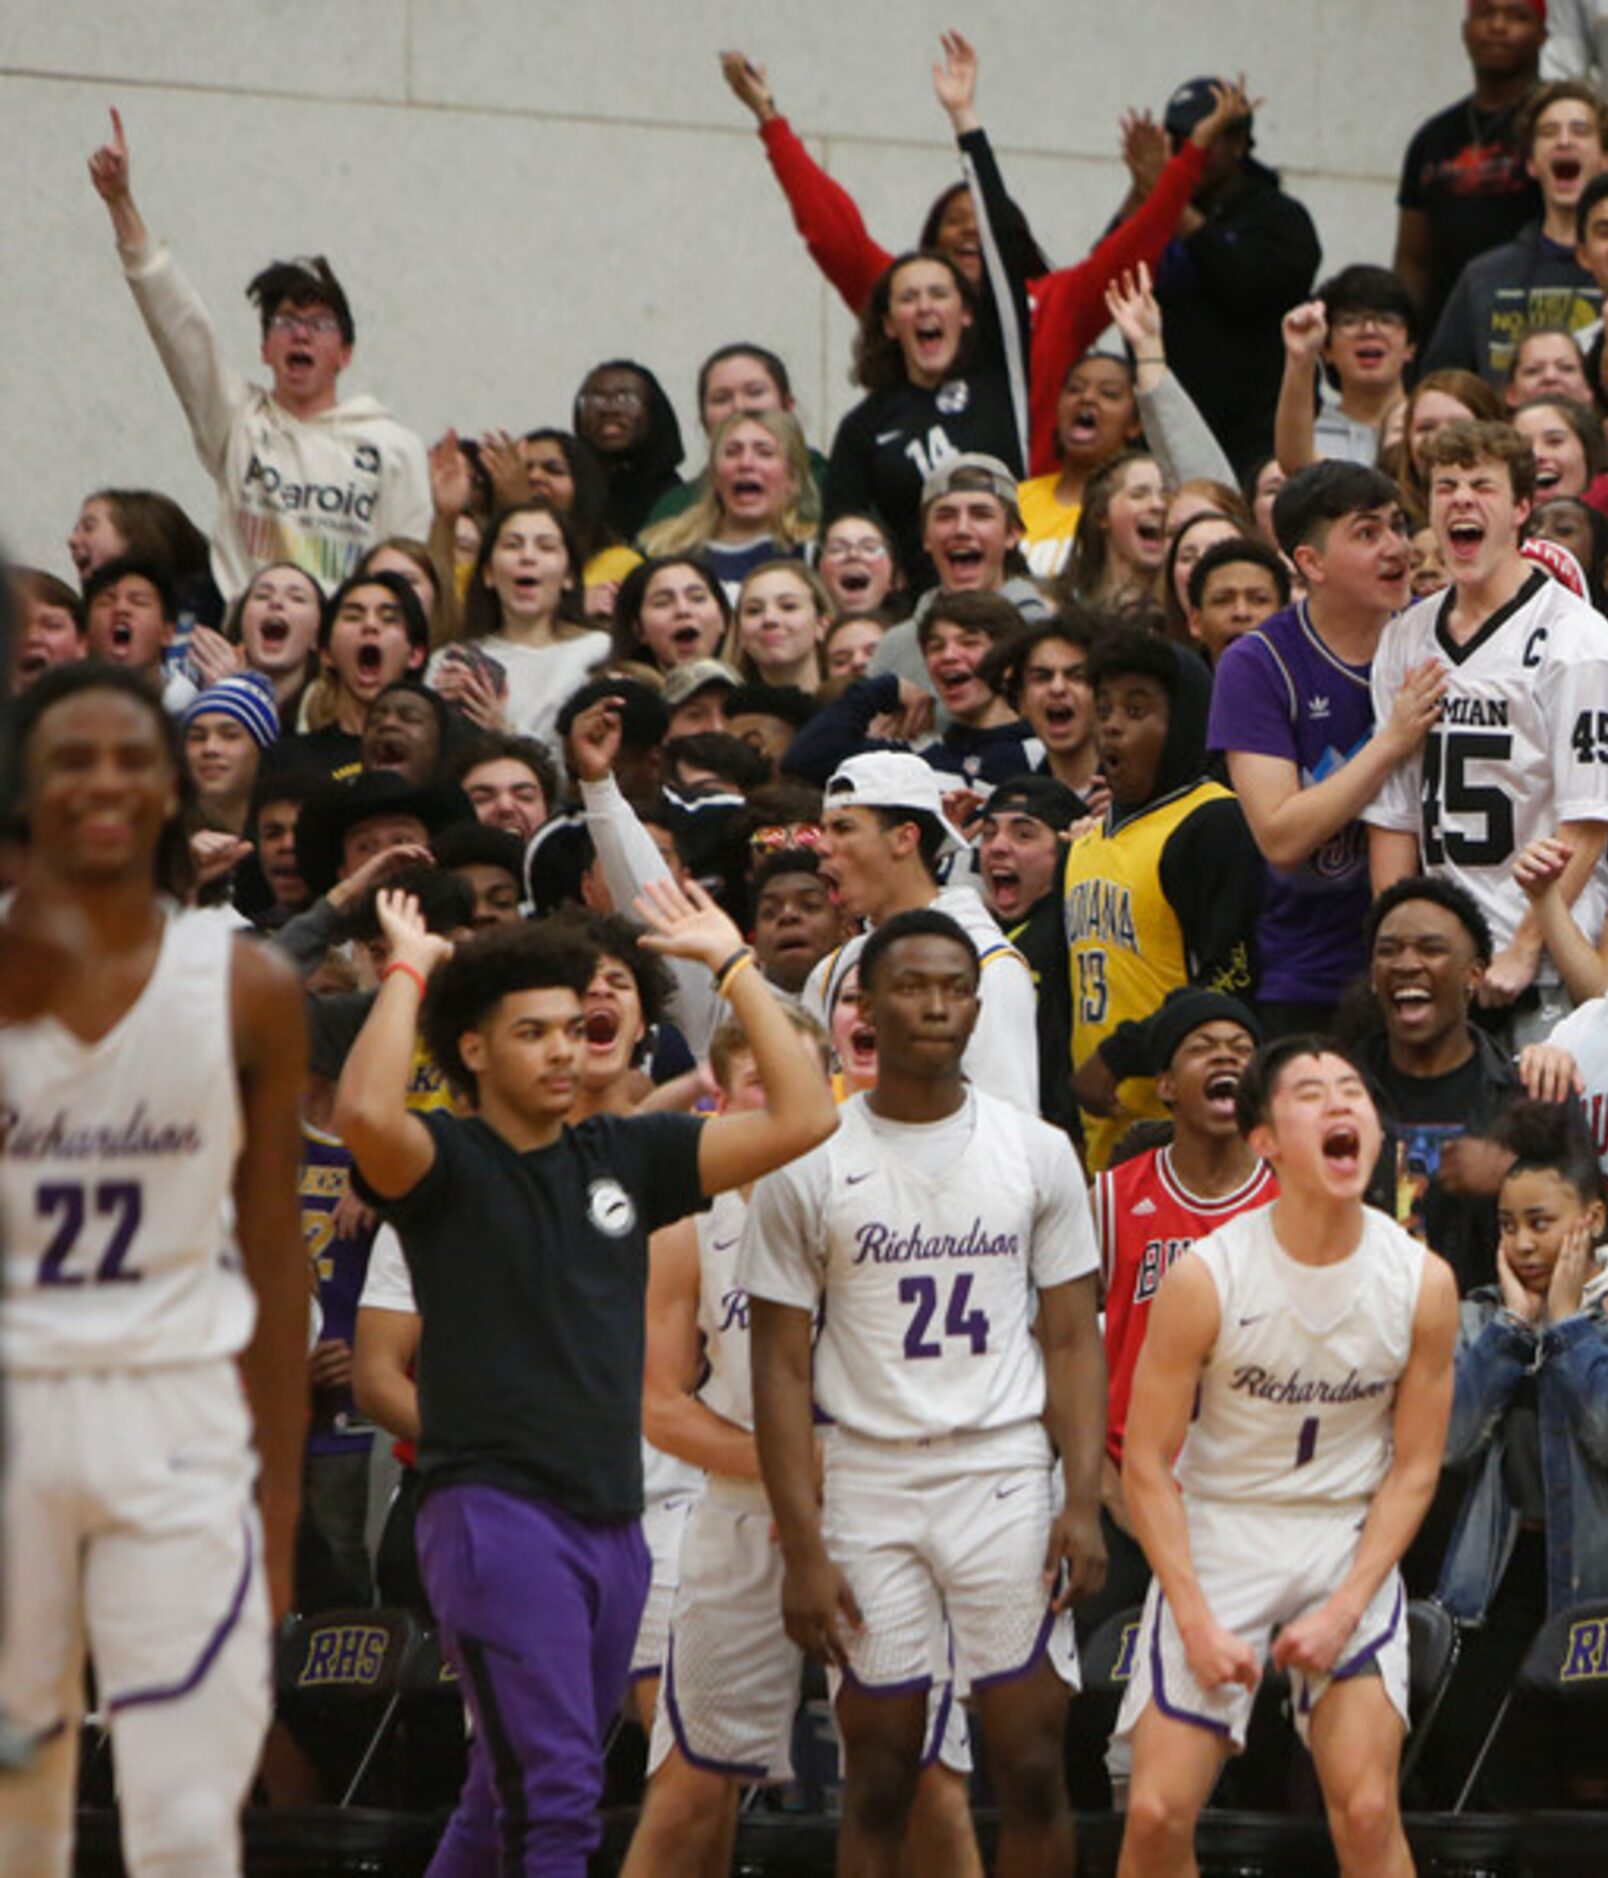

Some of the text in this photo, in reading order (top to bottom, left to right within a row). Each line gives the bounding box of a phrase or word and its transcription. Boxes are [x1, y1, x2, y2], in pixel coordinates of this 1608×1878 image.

[243, 454, 378, 522] Poaroid
[1522, 627, 1547, 667] C
[1436, 697, 1508, 727] MIAN
[1076, 948, 1109, 1023] 13
[35, 1178, 144, 1286] 22
[851, 1216, 1019, 1265] Richardson
[898, 1272, 990, 1361] 24
[298, 1625, 390, 1686] RHS
